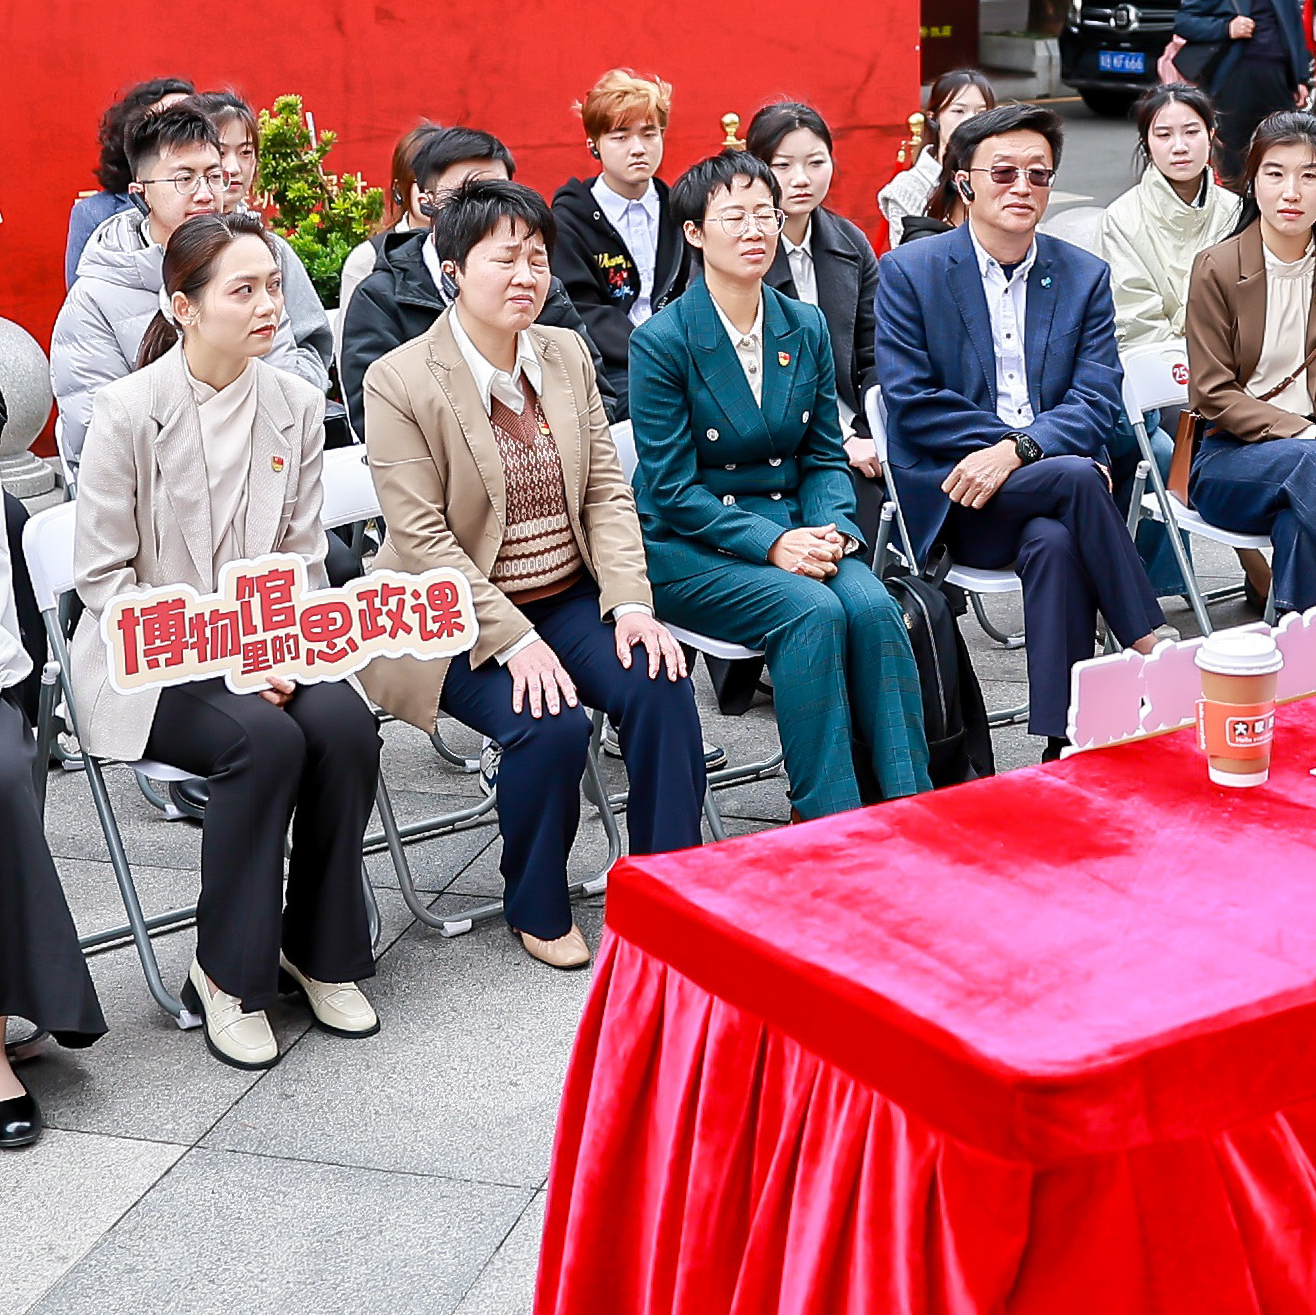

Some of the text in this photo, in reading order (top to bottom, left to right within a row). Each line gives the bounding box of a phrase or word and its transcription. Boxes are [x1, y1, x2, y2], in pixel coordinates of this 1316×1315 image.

[1173, 366, 1189, 382] 25
[117, 568, 297, 676] 博物馆
[240, 633, 300, 676] 里的
[300, 580, 466, 667] 思政课
